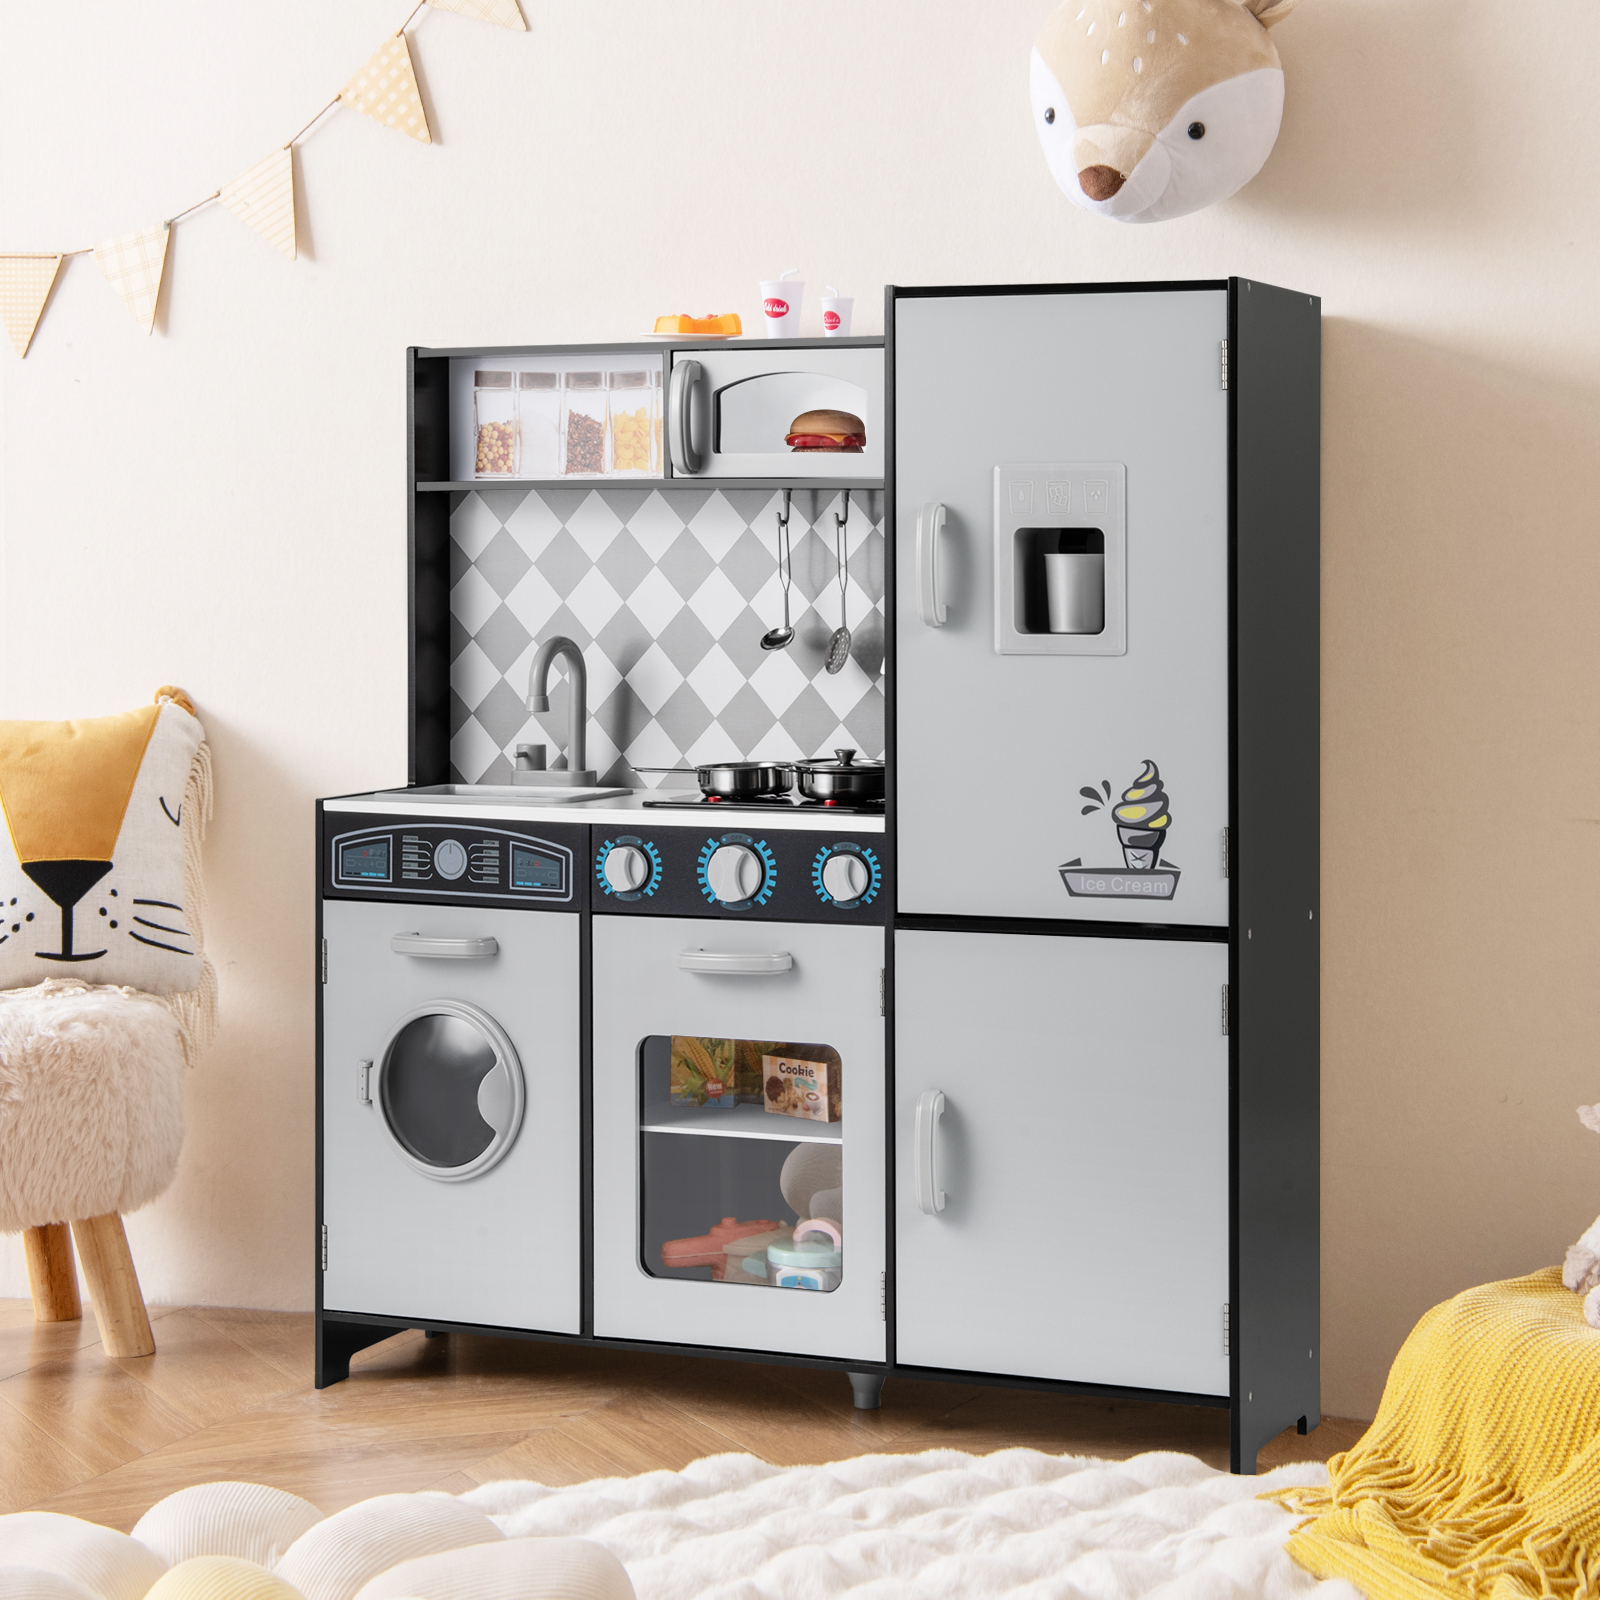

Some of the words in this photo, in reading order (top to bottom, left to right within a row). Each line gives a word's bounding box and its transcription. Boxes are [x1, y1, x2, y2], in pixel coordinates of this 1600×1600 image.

[1081, 875, 1106, 891] Ice
[1111, 876, 1169, 893] Cream
[778, 1062, 815, 1078] Cookie
[707, 1082, 723, 1092] New
